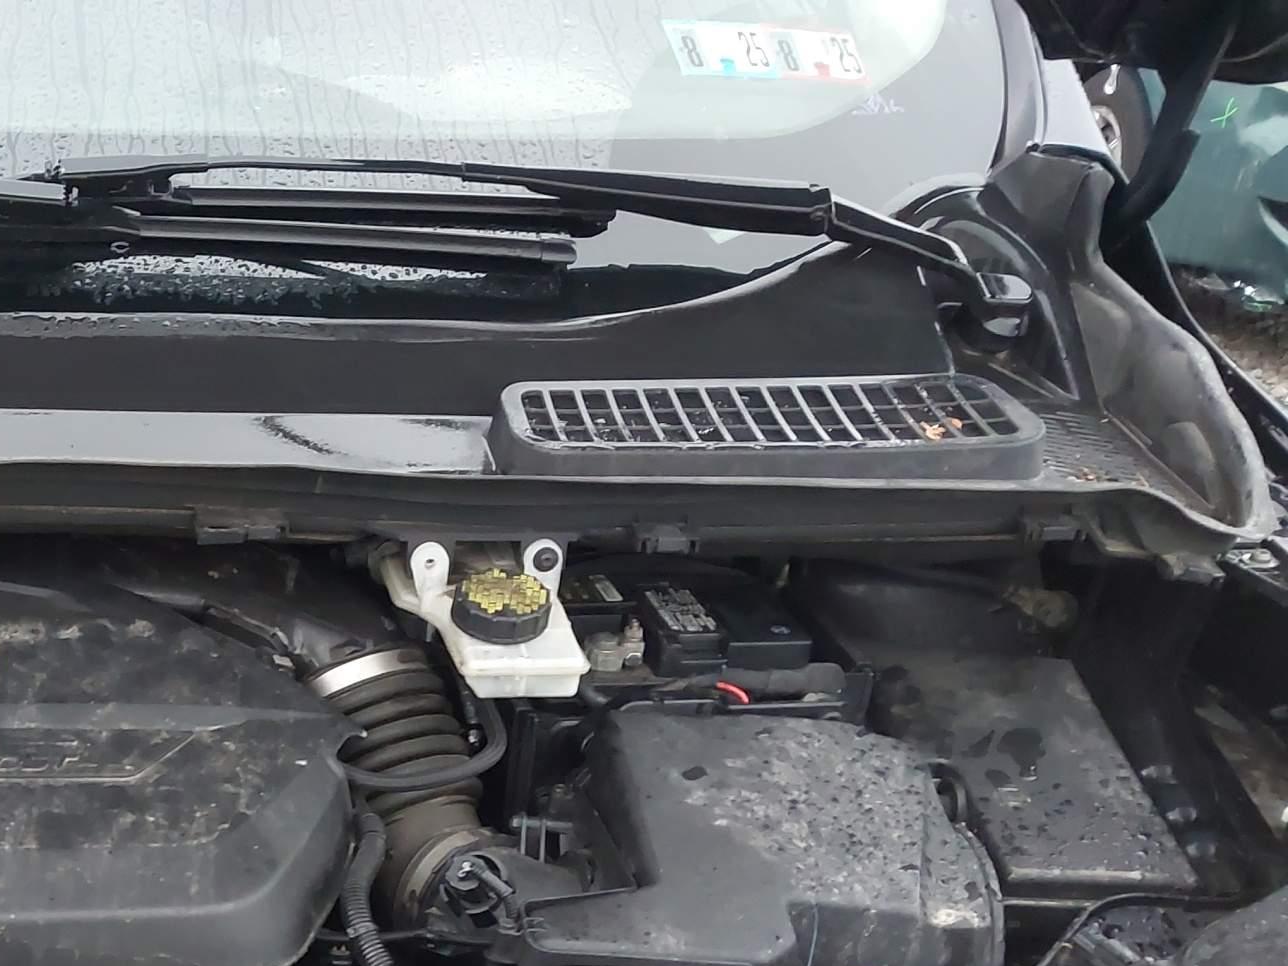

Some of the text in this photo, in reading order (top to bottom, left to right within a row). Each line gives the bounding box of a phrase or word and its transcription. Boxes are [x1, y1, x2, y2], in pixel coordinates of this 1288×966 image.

[680, 31, 770, 68] 8 25
[775, 36, 863, 74] 8 25
